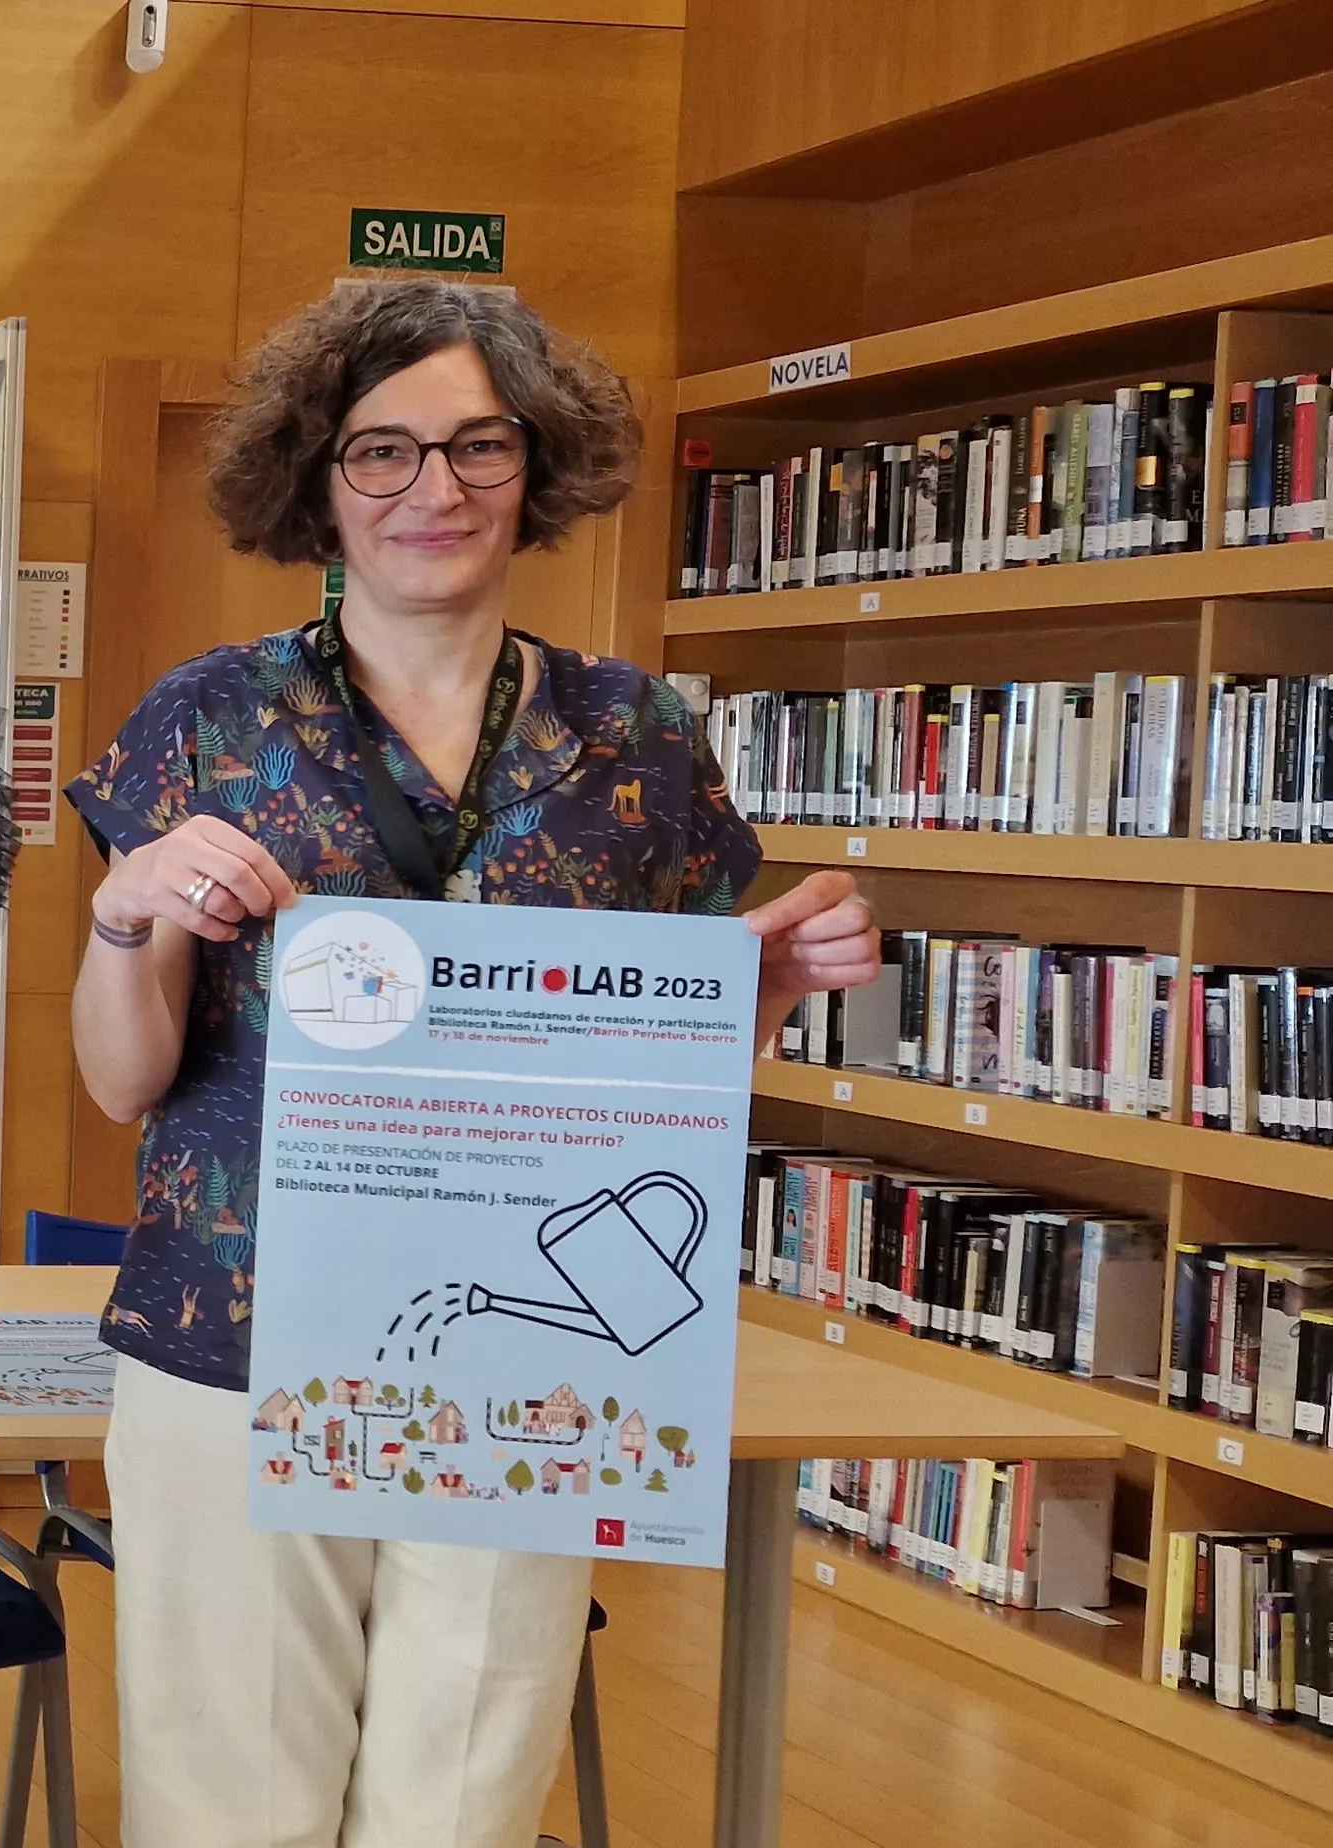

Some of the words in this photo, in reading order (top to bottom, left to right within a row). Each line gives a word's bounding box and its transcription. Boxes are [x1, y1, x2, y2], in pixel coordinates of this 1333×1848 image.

[363, 219, 490, 261] SALIDA
[770, 350, 850, 387] NOVELA
[18, 570, 69, 580] RRATIVOS
[653, 976, 722, 1000] 2023
[428, 1017, 487, 1029] Biblioteca
[491, 1020, 531, 1032] Ramón
[534, 1022, 542, 1032] J.
[546, 1023, 628, 1038] Sender/Barrio
[633, 1029, 686, 1041] Perpetuo
[690, 1031, 737, 1044] Socorro
[429, 1004, 502, 1018] Laboratorios
[505, 1008, 572, 1021] ciudadanos
[576, 1012, 591, 1023] de
[594, 1014, 644, 1027] creación
[648, 1019, 655, 1029] y
[658, 1017, 736, 1031] participación
[428, 1030, 439, 1039] 17
[442, 1033, 450, 1042] y
[453, 1031, 465, 1040] 18
[467, 1032, 483, 1042] de
[486, 1034, 550, 1046] noviembre
[279, 1089, 414, 1111] CONVOCATORIA
[418, 1098, 489, 1115] ABIERTA
[493, 1103, 505, 1116] A
[510, 1103, 609, 1122] PROYECTOS
[613, 1110, 729, 1130] CIUDADANOS
[278, 1114, 340, 1130] ¿Tienes
[345, 1119, 376, 1132] una
[382, 1119, 418, 1135] idea
[423, 1125, 462, 1139] para
[467, 1127, 534, 1143] mejorar
[540, 1131, 558, 1144] tu
[563, 1131, 625, 1148] barrio?
[277, 1140, 319, 1153] PLAZO
[322, 1143, 340, 1154] DE
[343, 1143, 442, 1161] PRESENTACIÓN
[445, 1151, 463, 1163] DE
[466, 1152, 544, 1168] PROYECTOS
[276, 1158, 299, 1169] DEL
[303, 1159, 311, 1170] 2
[314, 1160, 332, 1172] AL
[336, 1162, 351, 1173] 14
[355, 1163, 372, 1175] DE
[376, 1164, 439, 1179] OCTUBRE
[275, 1178, 350, 1195] Biblioteca
[354, 1182, 429, 1201] Municipal
[434, 1188, 486, 1204] Ramón
[489, 1192, 499, 1206] J.
[504, 1192, 557, 1207] Sender
[645, 1534, 686, 1546] Huesca
